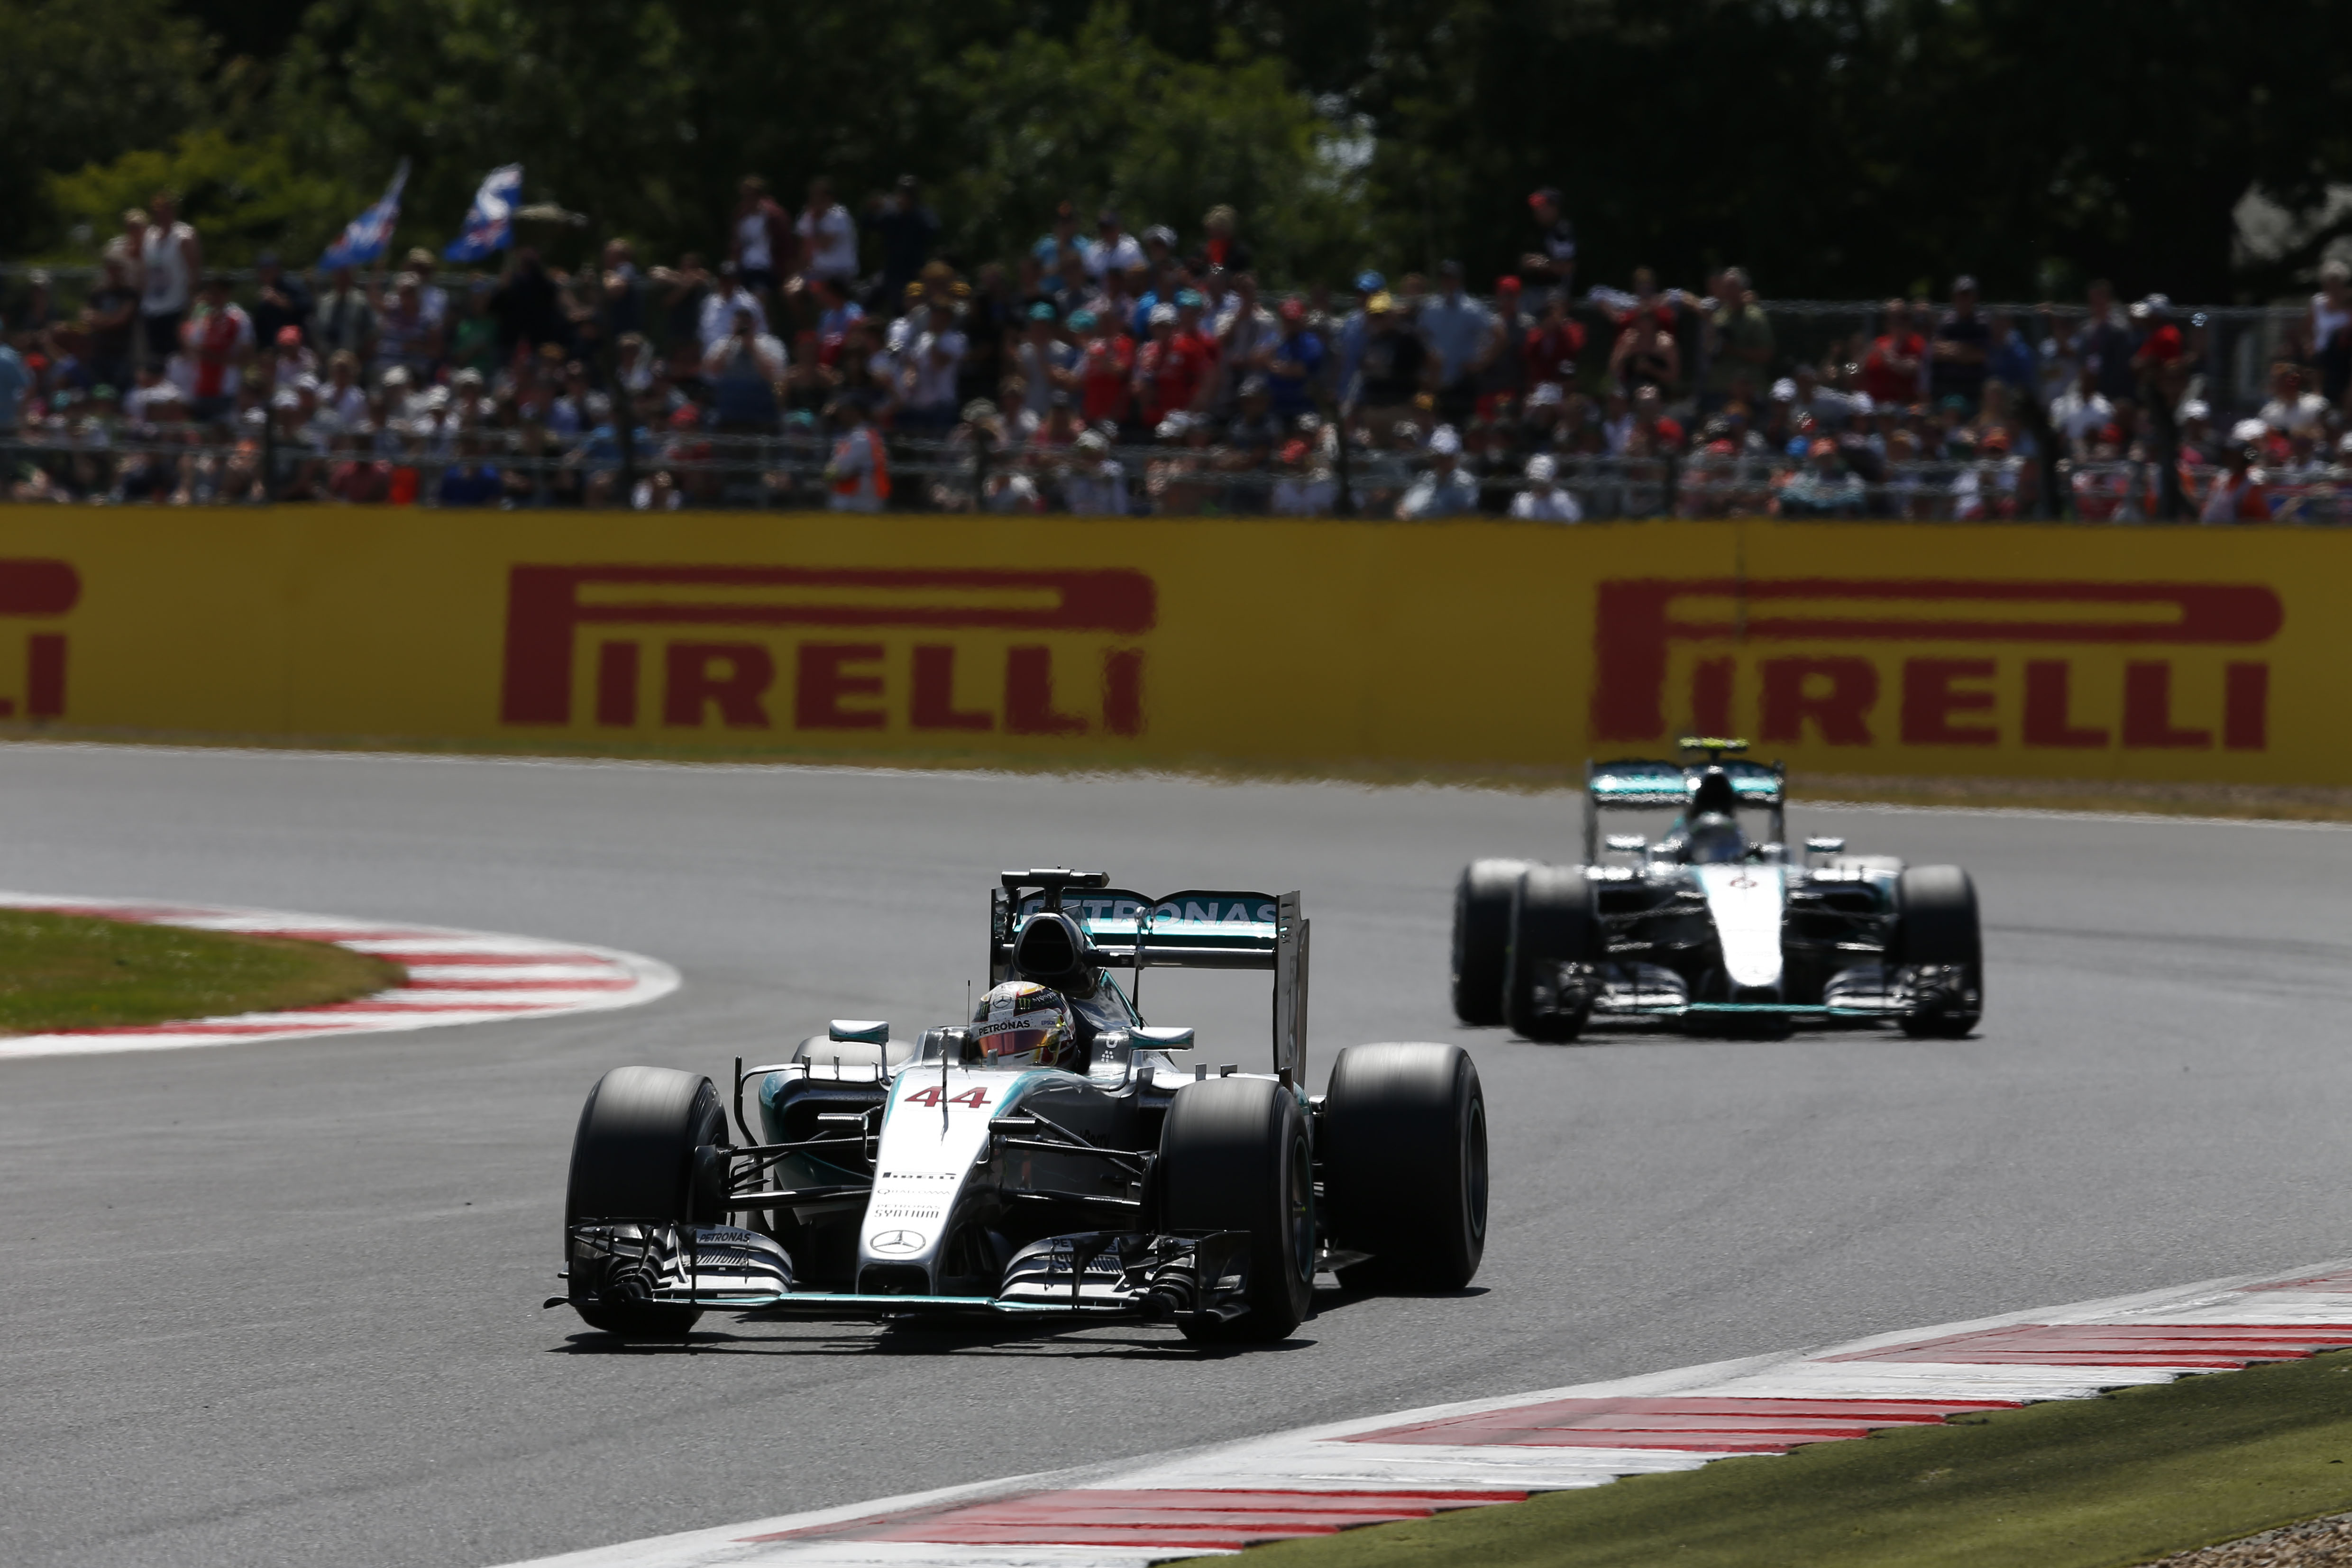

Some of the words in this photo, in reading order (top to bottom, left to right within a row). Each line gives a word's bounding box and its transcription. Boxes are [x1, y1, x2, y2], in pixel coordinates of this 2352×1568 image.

[500, 563, 1158, 736] PIRELLI
[1591, 580, 2283, 751] PIRELLI
[979, 1019, 1030, 1036] PETRONAS
[905, 1086, 991, 1108] 44
[882, 1172, 956, 1180] PIRELLI
[874, 1210, 939, 1219] SYNTIUM
[699, 1232, 751, 1242] PETRONAS
